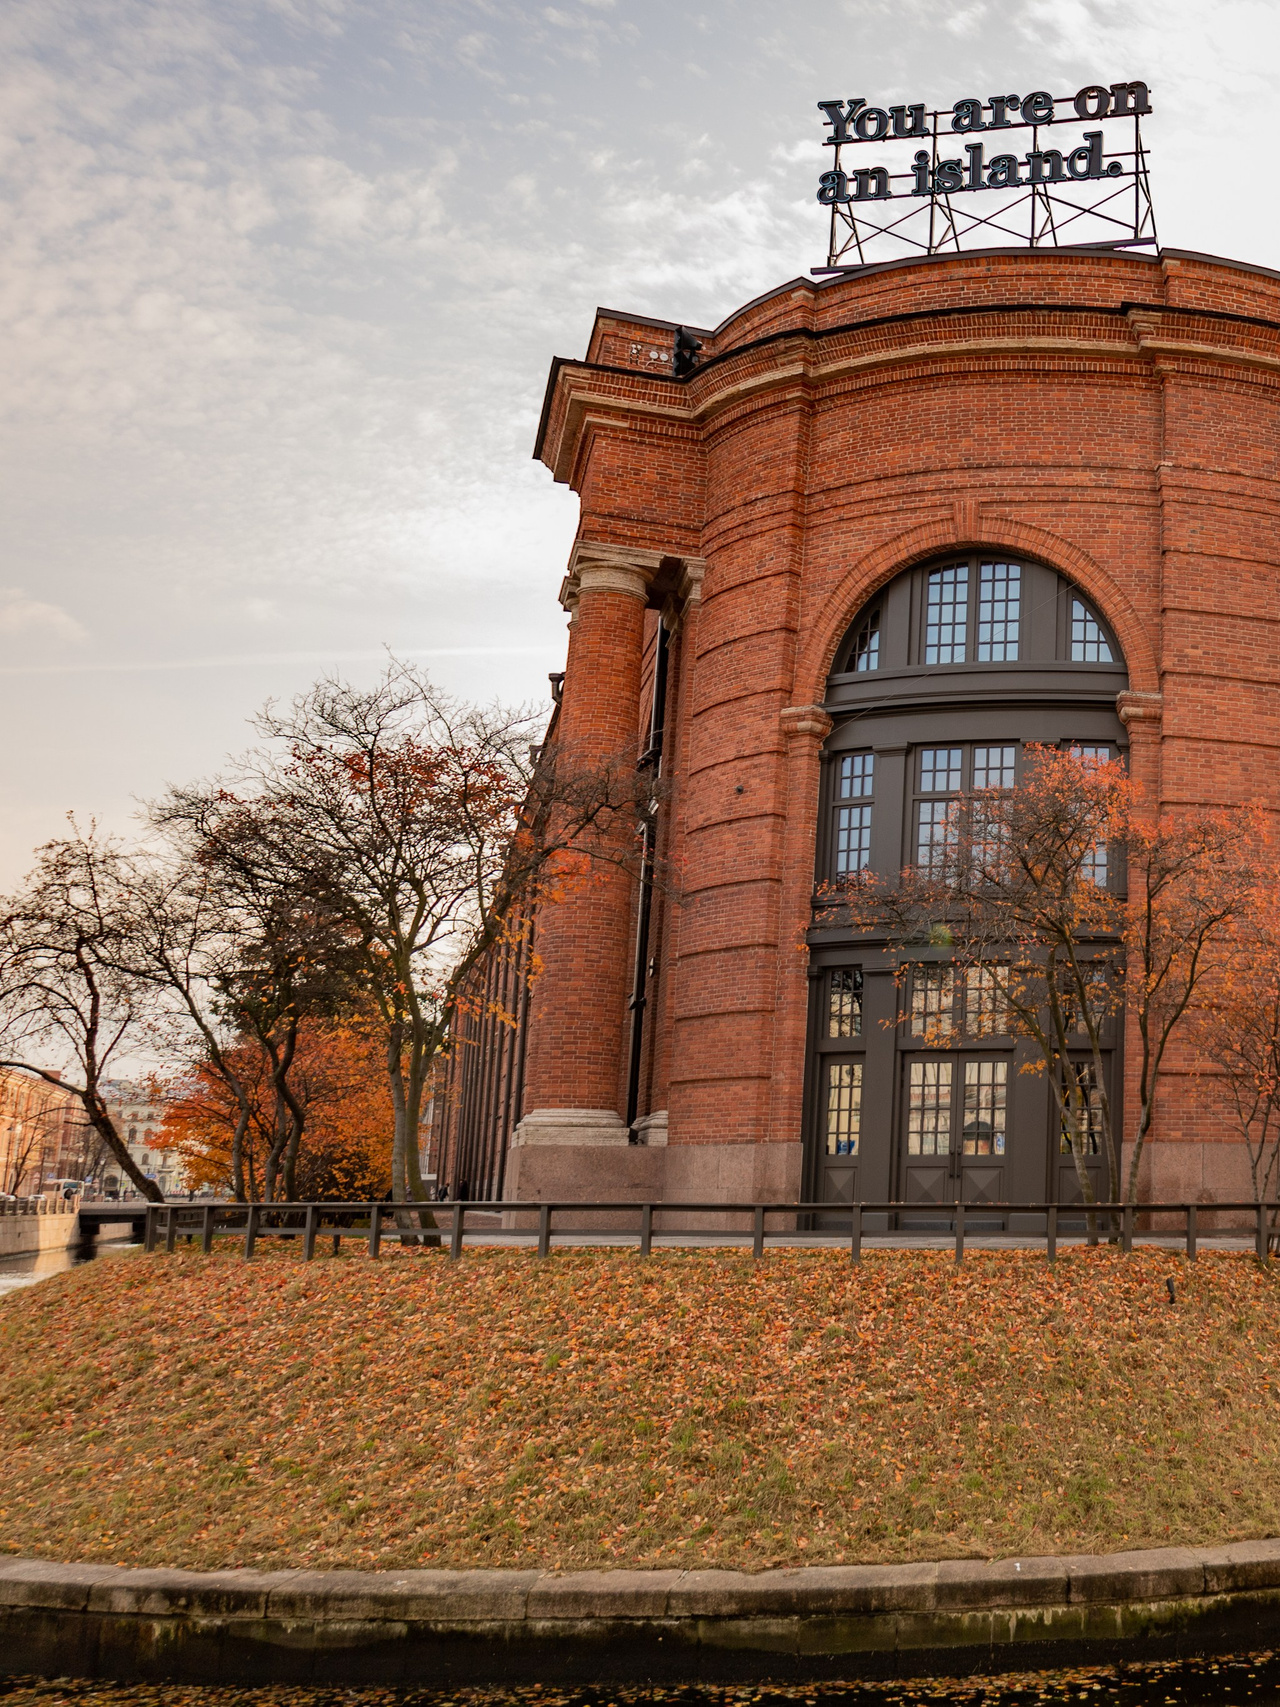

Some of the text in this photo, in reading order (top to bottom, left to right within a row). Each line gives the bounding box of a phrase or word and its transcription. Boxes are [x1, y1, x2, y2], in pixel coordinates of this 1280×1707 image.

[818, 80, 1153, 143] You are on
[816, 131, 1123, 204] an island.
